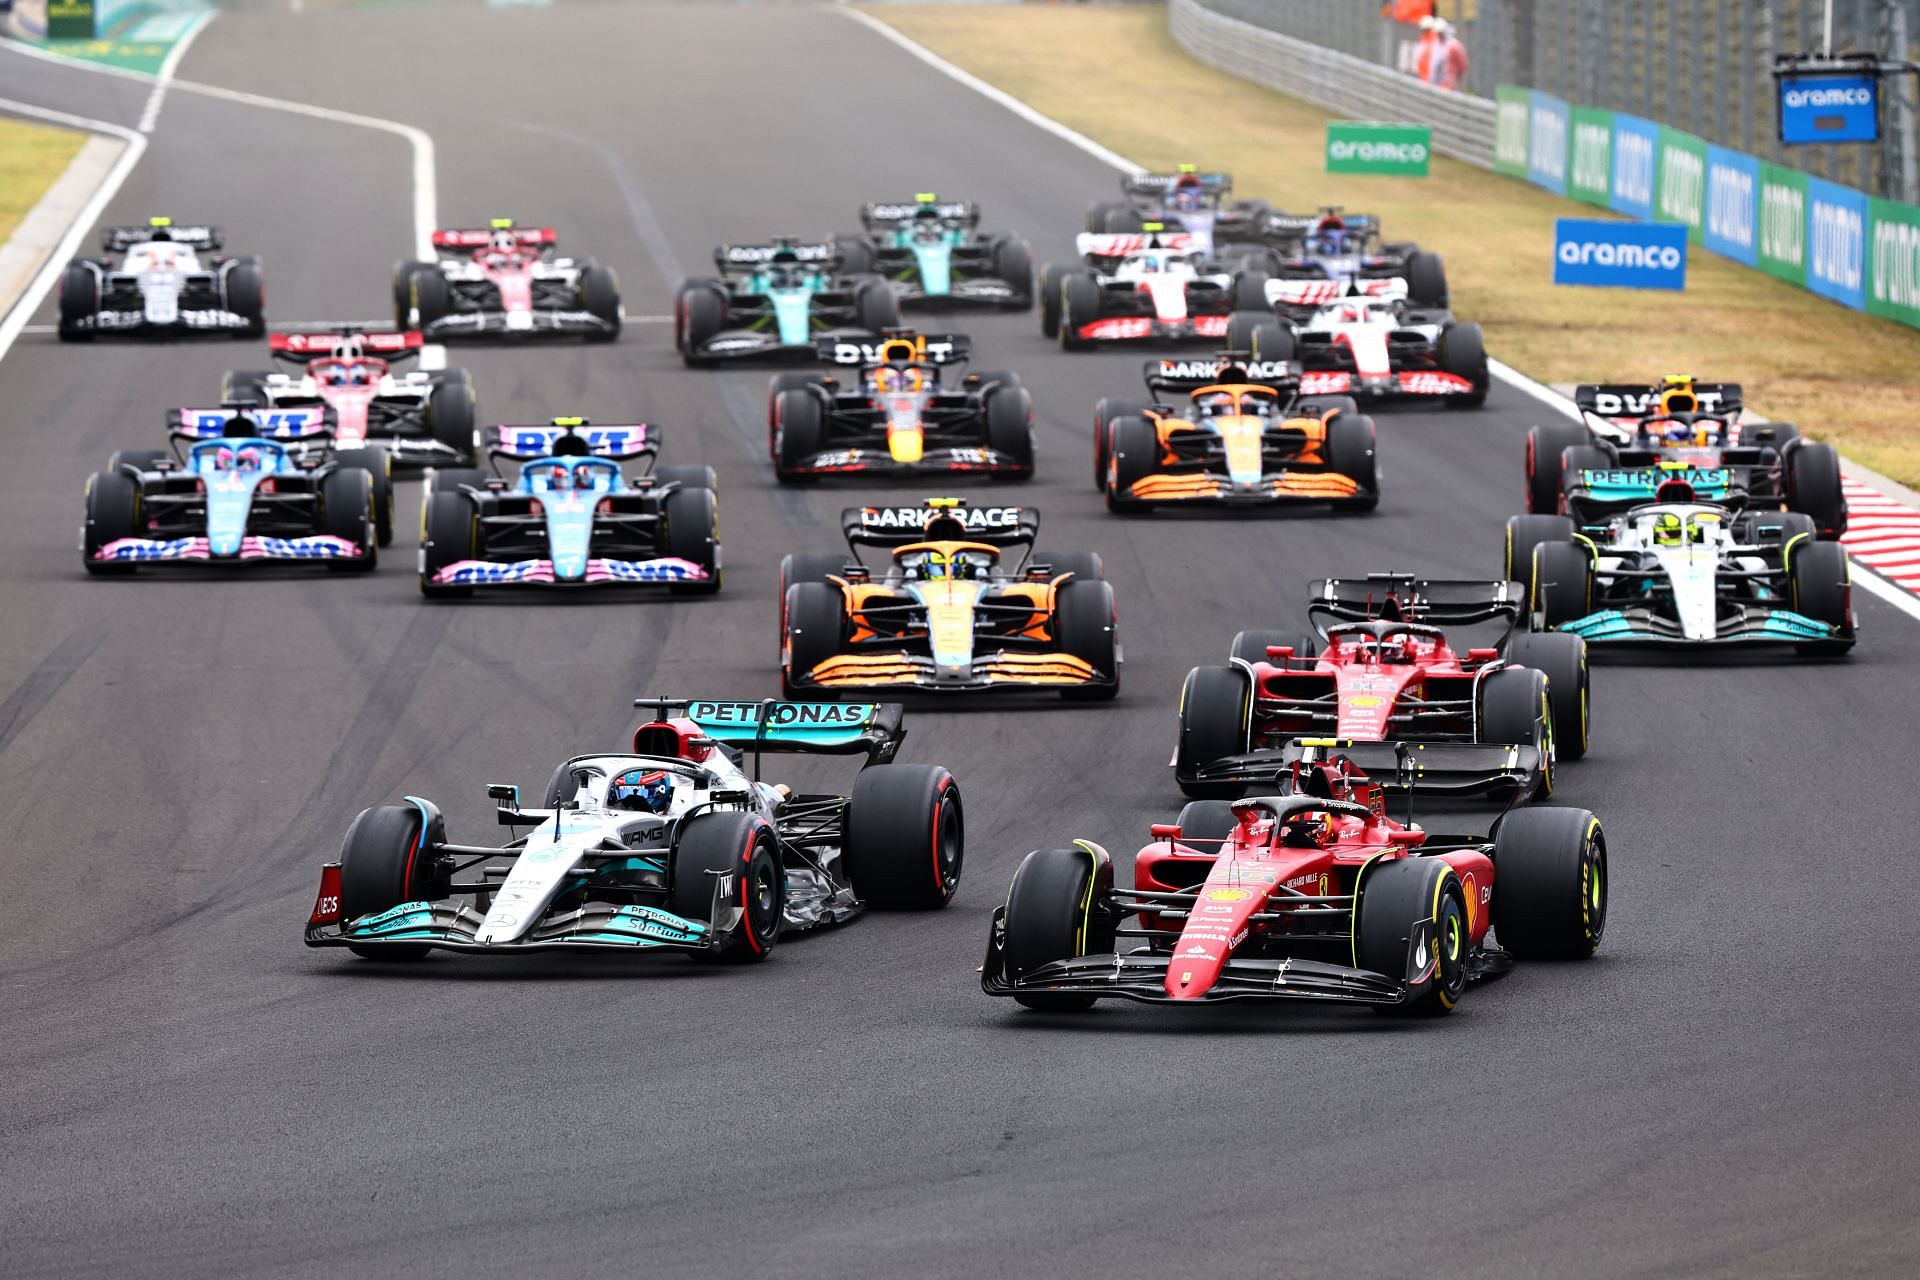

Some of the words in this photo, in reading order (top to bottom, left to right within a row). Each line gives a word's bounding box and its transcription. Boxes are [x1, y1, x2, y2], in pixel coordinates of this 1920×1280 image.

[1785, 88, 1871, 108] aramco
[1330, 138, 1428, 163] aramco
[1559, 240, 1681, 270] aramco
[861, 507, 1019, 527] DARKRACE
[1327, 800, 1360, 811] Snapdragon
[629, 826, 664, 846] AMG
[1286, 875, 1305, 889] RICHARD
[1305, 872, 1318, 885] MILLE
[631, 906, 690, 929] PETRONAS
[628, 918, 688, 940] Syntium
